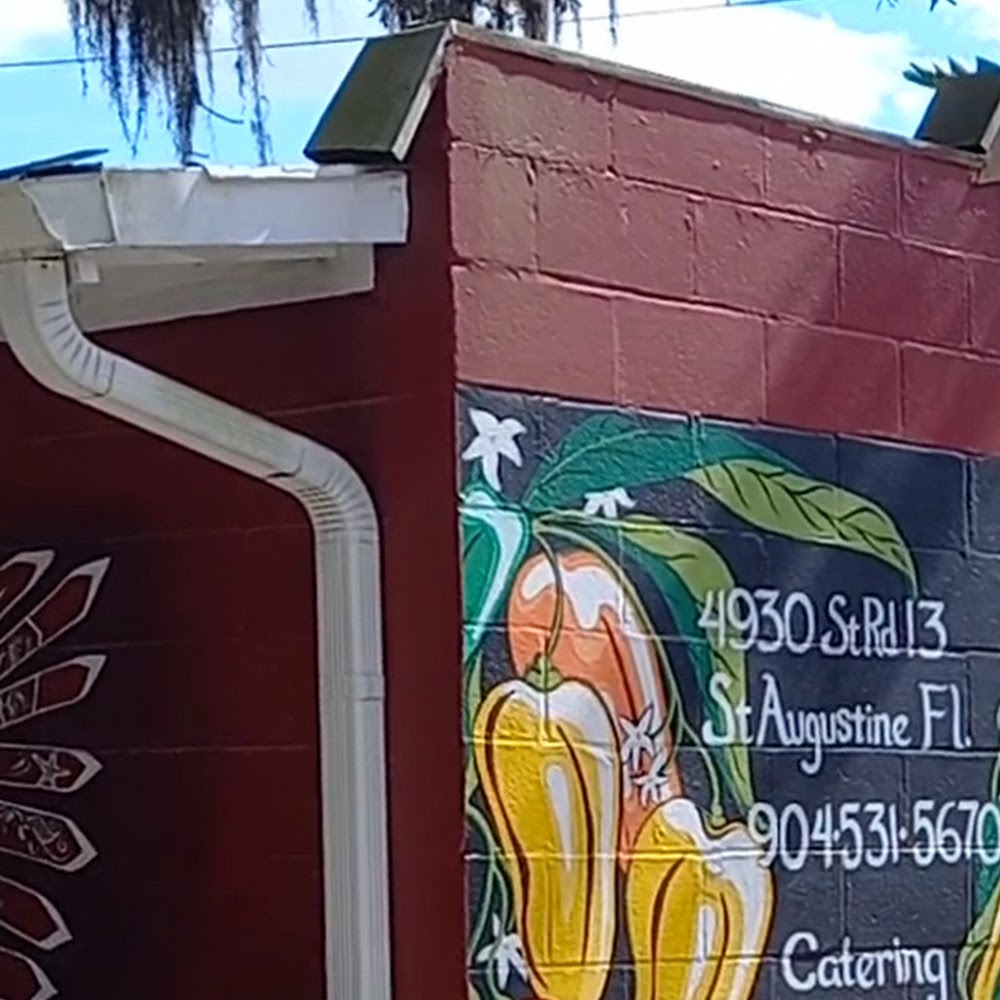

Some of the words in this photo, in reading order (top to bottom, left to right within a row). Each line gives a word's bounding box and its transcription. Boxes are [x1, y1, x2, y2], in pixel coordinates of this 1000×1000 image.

[698, 588, 814, 653] 4930
[702, 672, 753, 746] St
[756, 673, 912, 774] Augustine
